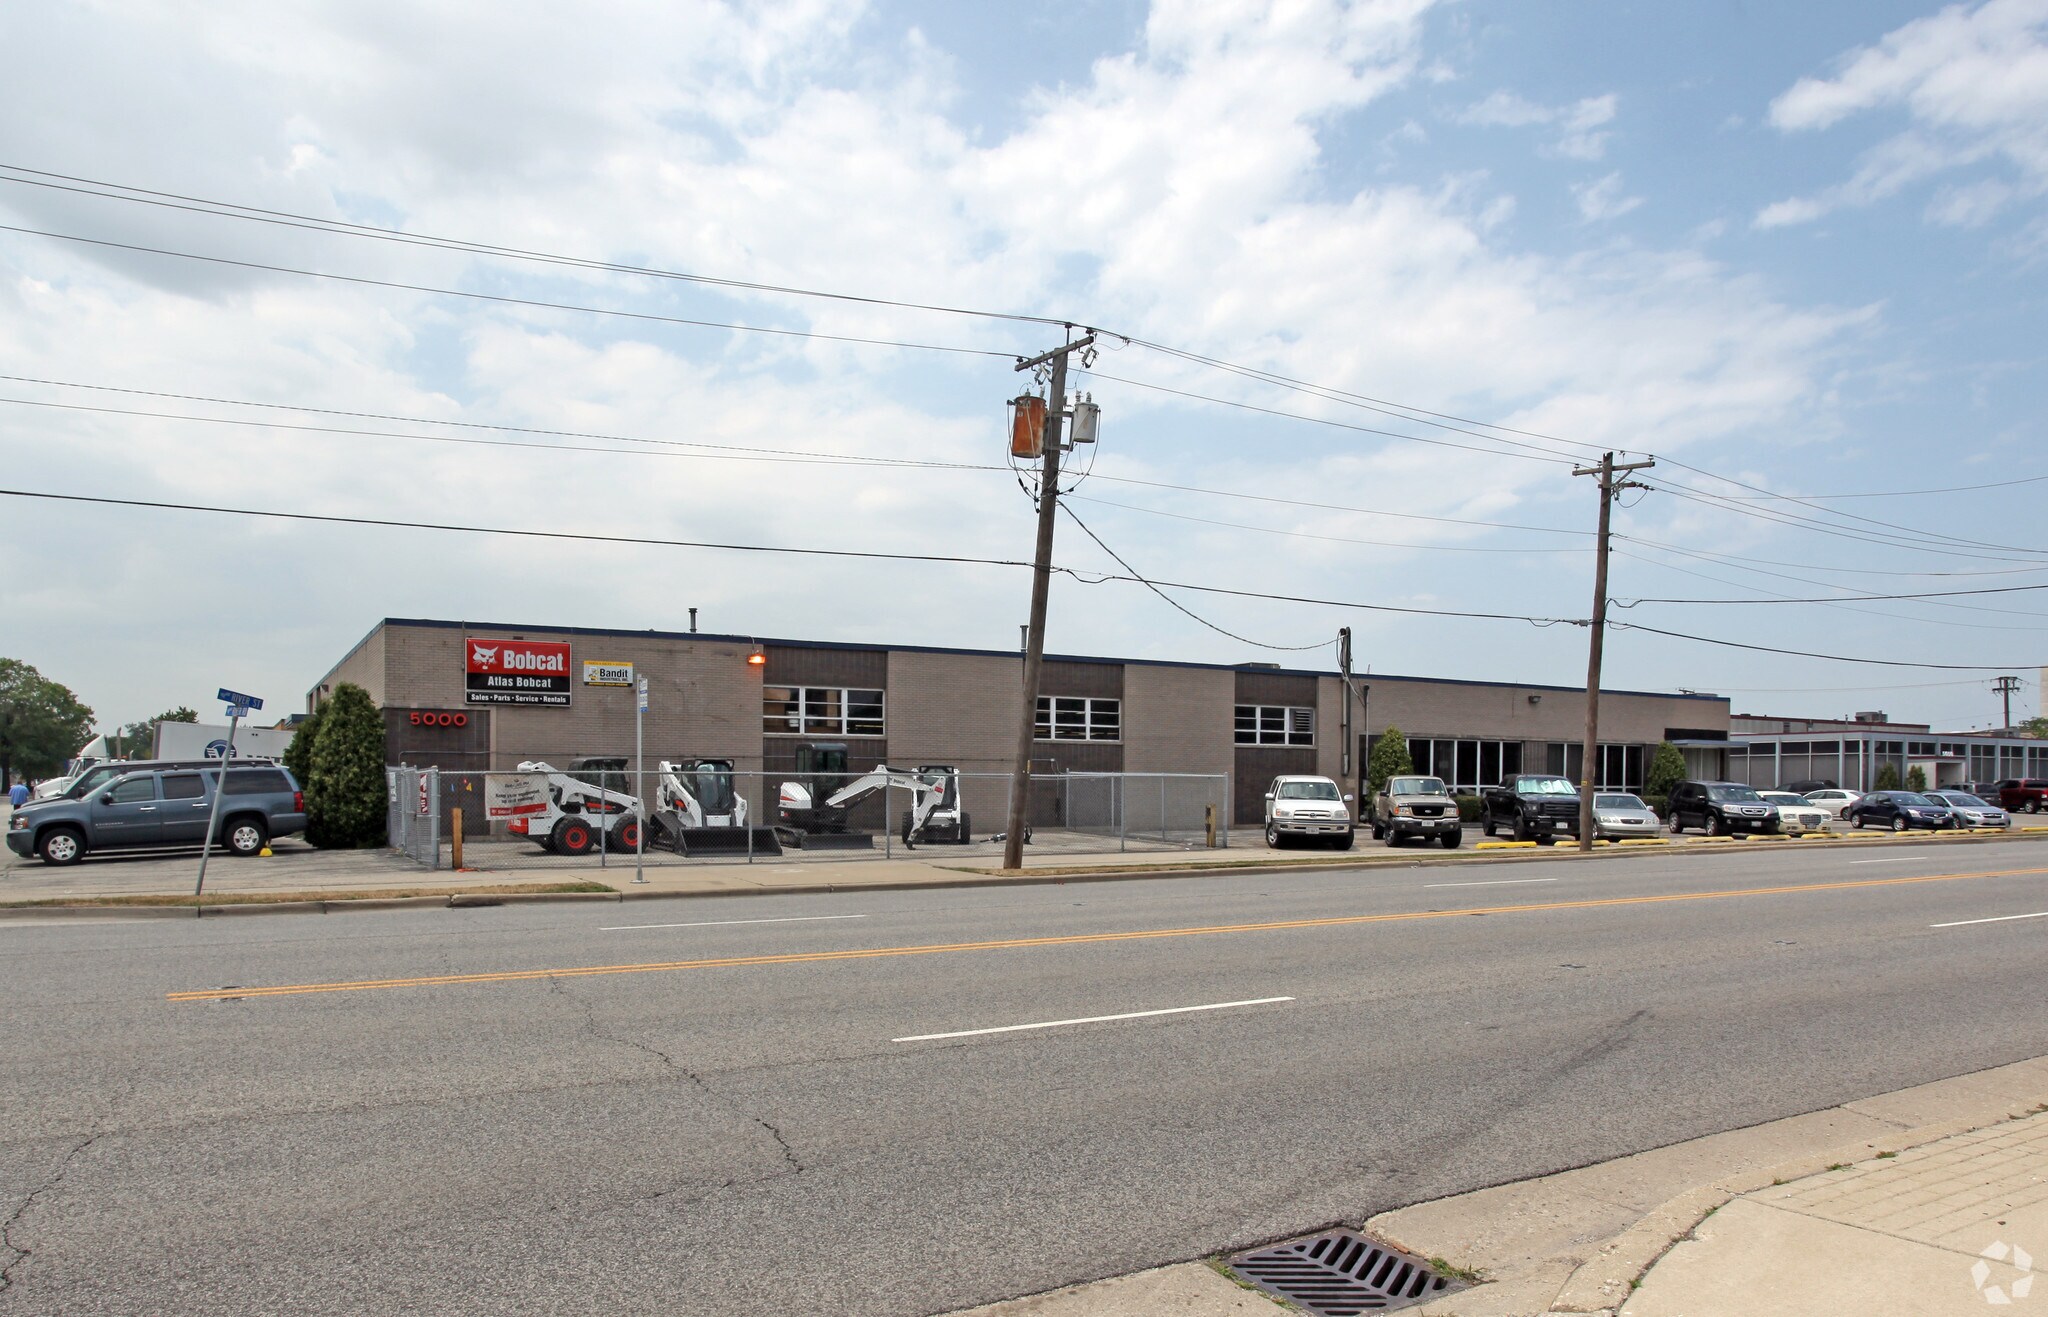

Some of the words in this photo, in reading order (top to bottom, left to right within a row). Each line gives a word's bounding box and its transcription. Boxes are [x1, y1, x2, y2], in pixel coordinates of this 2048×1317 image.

[503, 649, 564, 671] Bobcat
[600, 668, 628, 677] Bandit
[487, 675, 514, 687] Atlas
[516, 676, 552, 688] Bobcat
[231, 693, 250, 705] RIVER
[253, 699, 260, 708] ST
[471, 693, 489, 701] Sales
[493, 694, 511, 702] Parts
[515, 694, 539, 702] Service
[543, 695, 567, 703] Rentals
[410, 712, 468, 726] 5000
